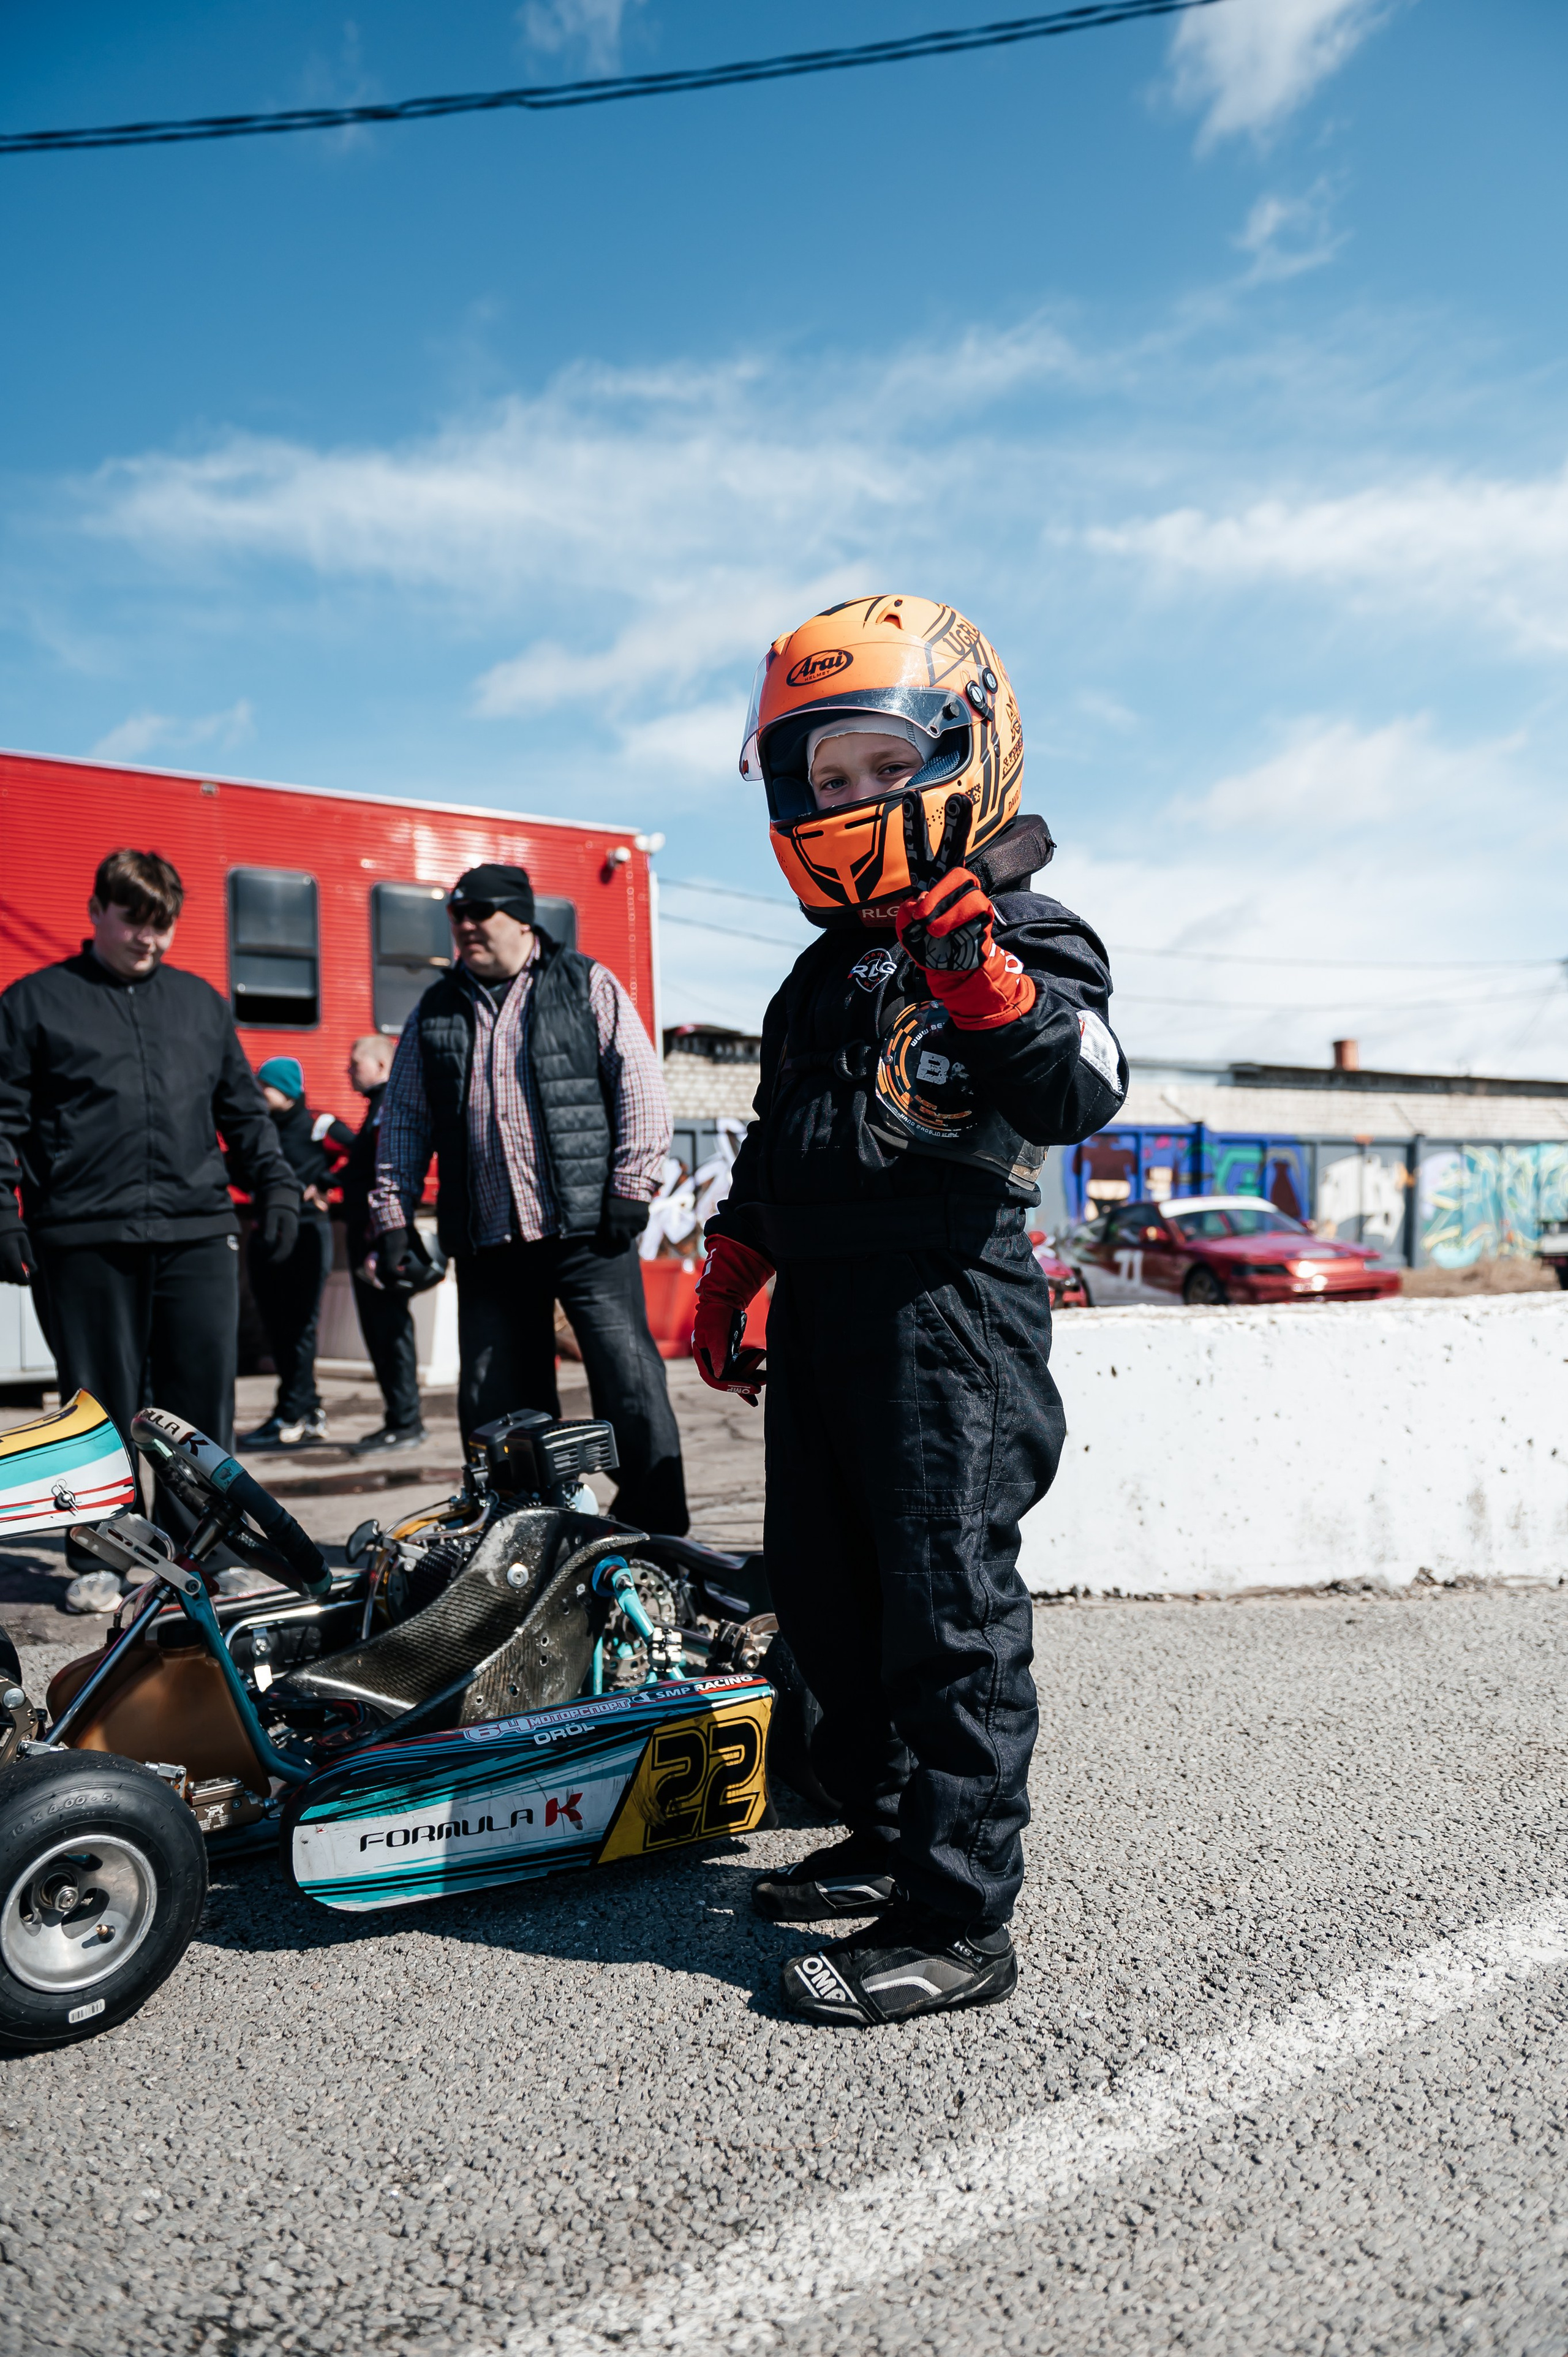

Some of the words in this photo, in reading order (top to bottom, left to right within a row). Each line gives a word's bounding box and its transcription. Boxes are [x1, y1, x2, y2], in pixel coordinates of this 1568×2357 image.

[790, 651, 844, 684] Arai
[804, 670, 830, 681] HELMET
[848, 961, 897, 978] RLG
[900, 1113, 915, 1126] HAND
[178, 1431, 210, 1457] K
[656, 1688, 690, 1699] SMP
[694, 1675, 753, 1691] RACING
[466, 1717, 532, 1741] 64
[529, 1700, 628, 1726] МОТОРСПОРТ
[533, 1722, 595, 1745] ORÖL
[643, 1716, 761, 1851] 22
[48, 1795, 86, 1814] 4.00
[101, 1792, 113, 1803] 5
[360, 1808, 533, 1852] FORMULA
[545, 1792, 583, 1828] K
[802, 1957, 846, 2002] OMP
